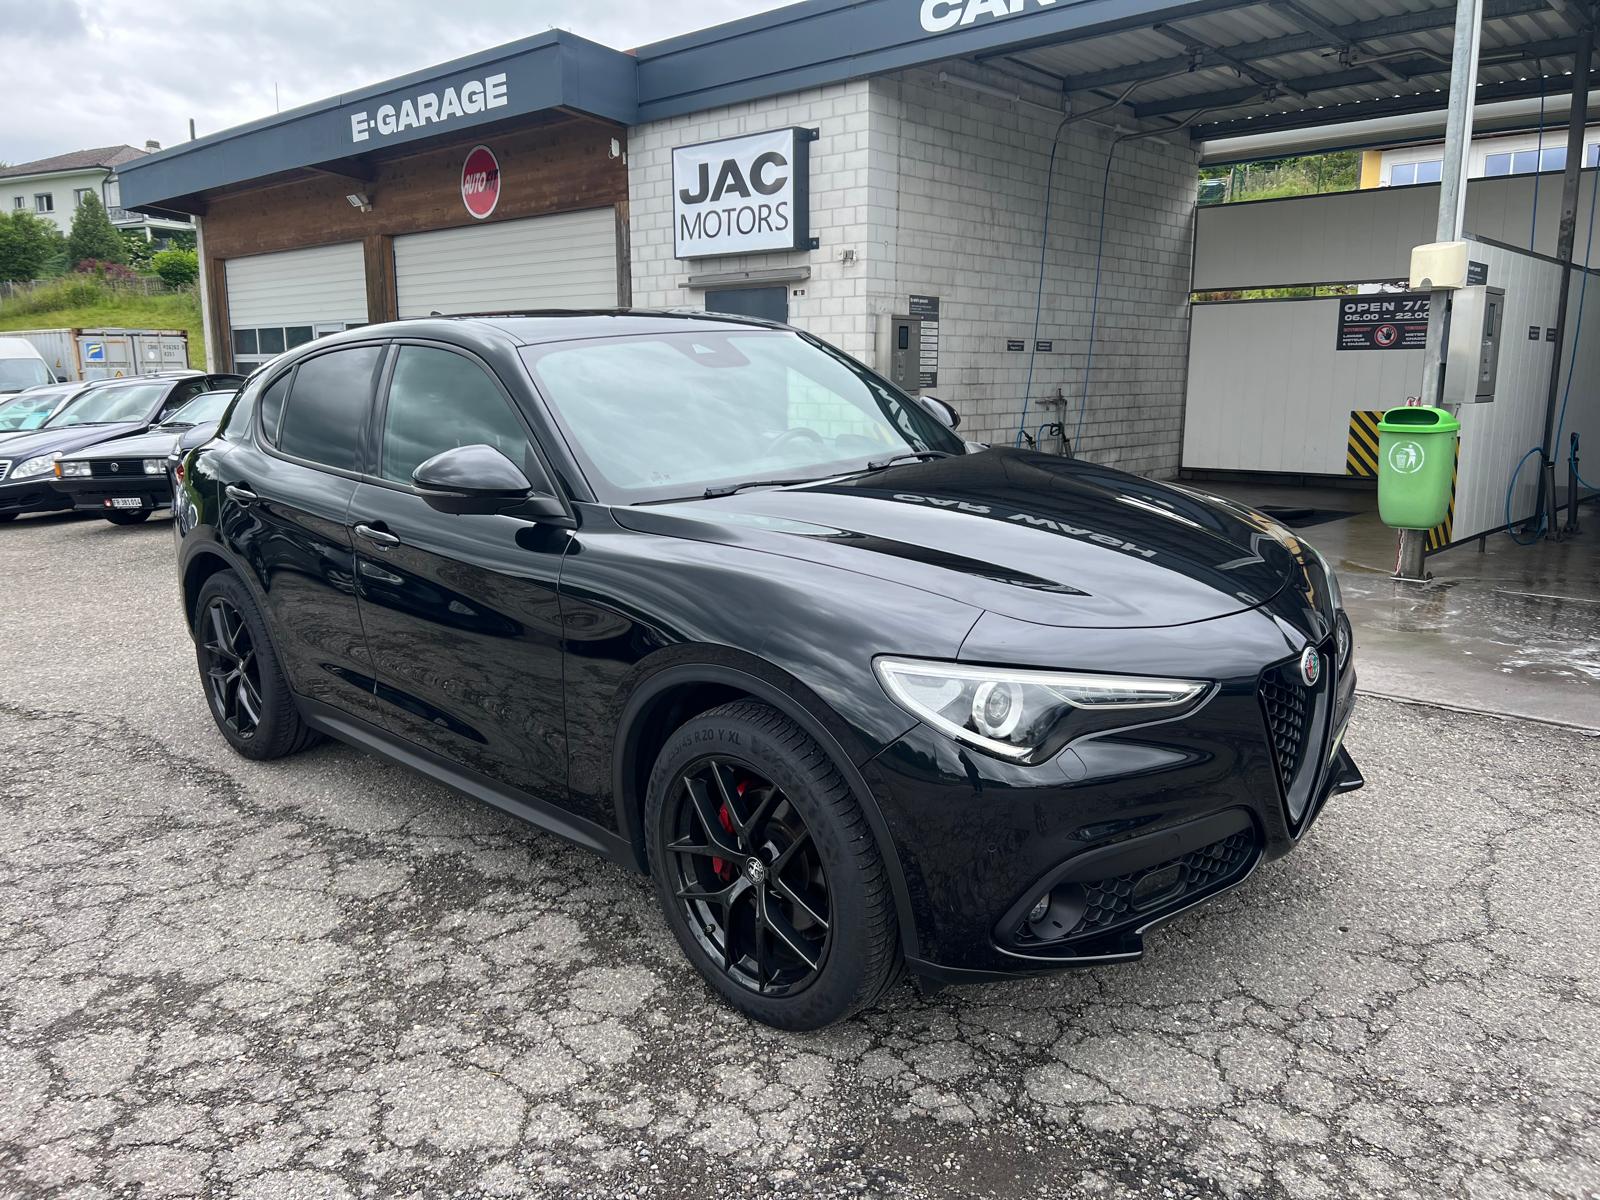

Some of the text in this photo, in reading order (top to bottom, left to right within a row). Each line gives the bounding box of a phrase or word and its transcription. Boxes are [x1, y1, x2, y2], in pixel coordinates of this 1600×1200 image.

[679, 151, 788, 205] JAC
[680, 202, 788, 241] MOTORS
[1344, 300, 1430, 313] OPEN 7/7
[1344, 313, 1379, 321] 06.00
